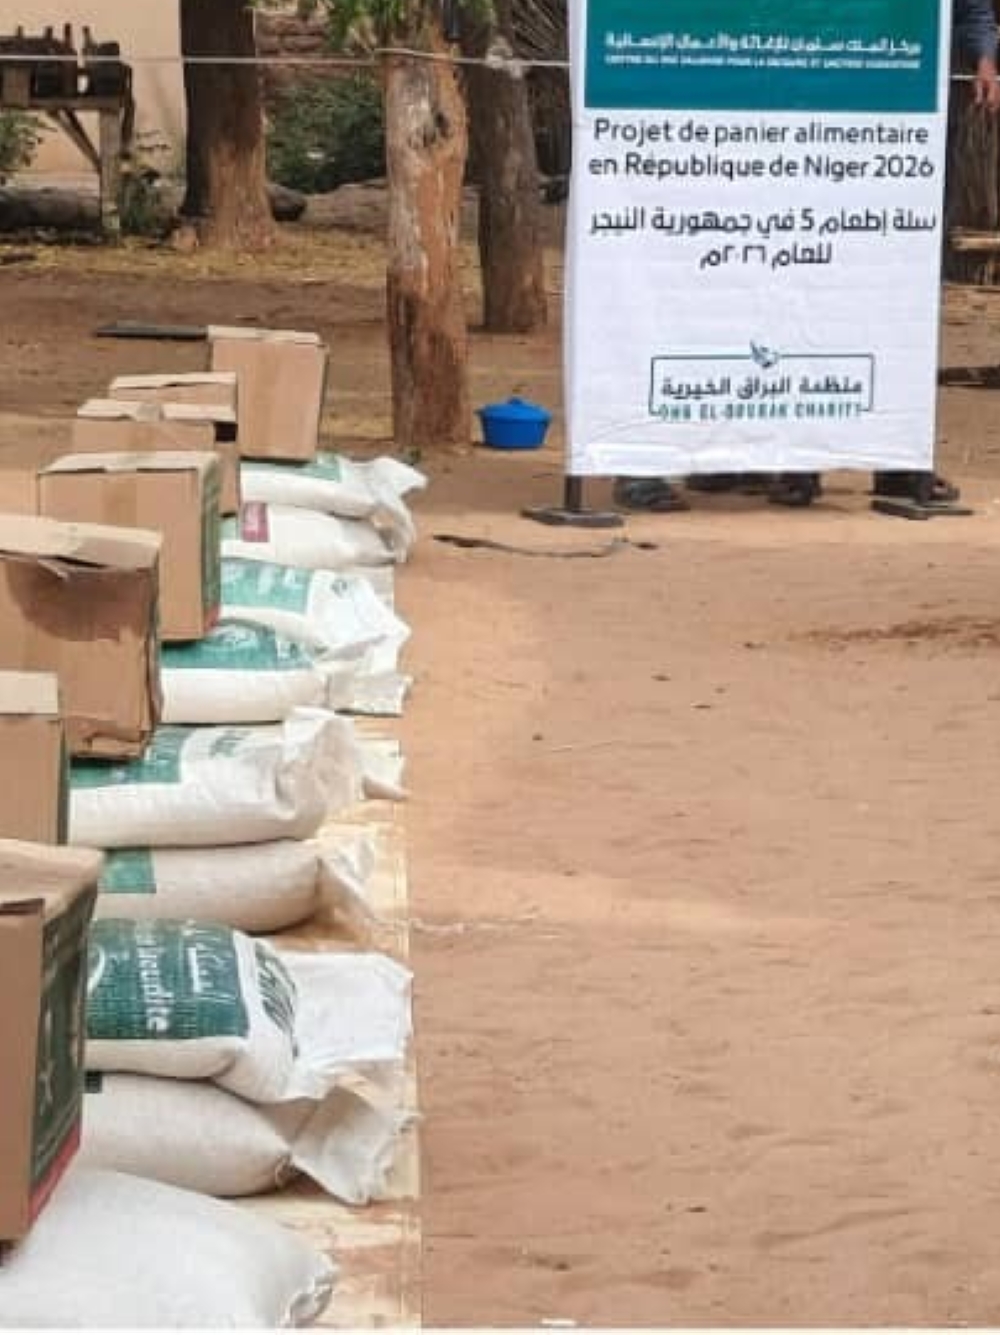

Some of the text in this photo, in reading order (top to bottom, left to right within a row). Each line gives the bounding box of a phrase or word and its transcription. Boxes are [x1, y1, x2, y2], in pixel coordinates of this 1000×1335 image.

[594, 117, 929, 147] Projet de panier alimentaire
[588, 151, 935, 182] en République de Niger 2026
[590, 206, 937, 239] سلة إطعام 5 في جمهورية النيجر
[772, 241, 833, 271] للعام
[661, 375, 863, 400] منظمة البراق الخيرية
